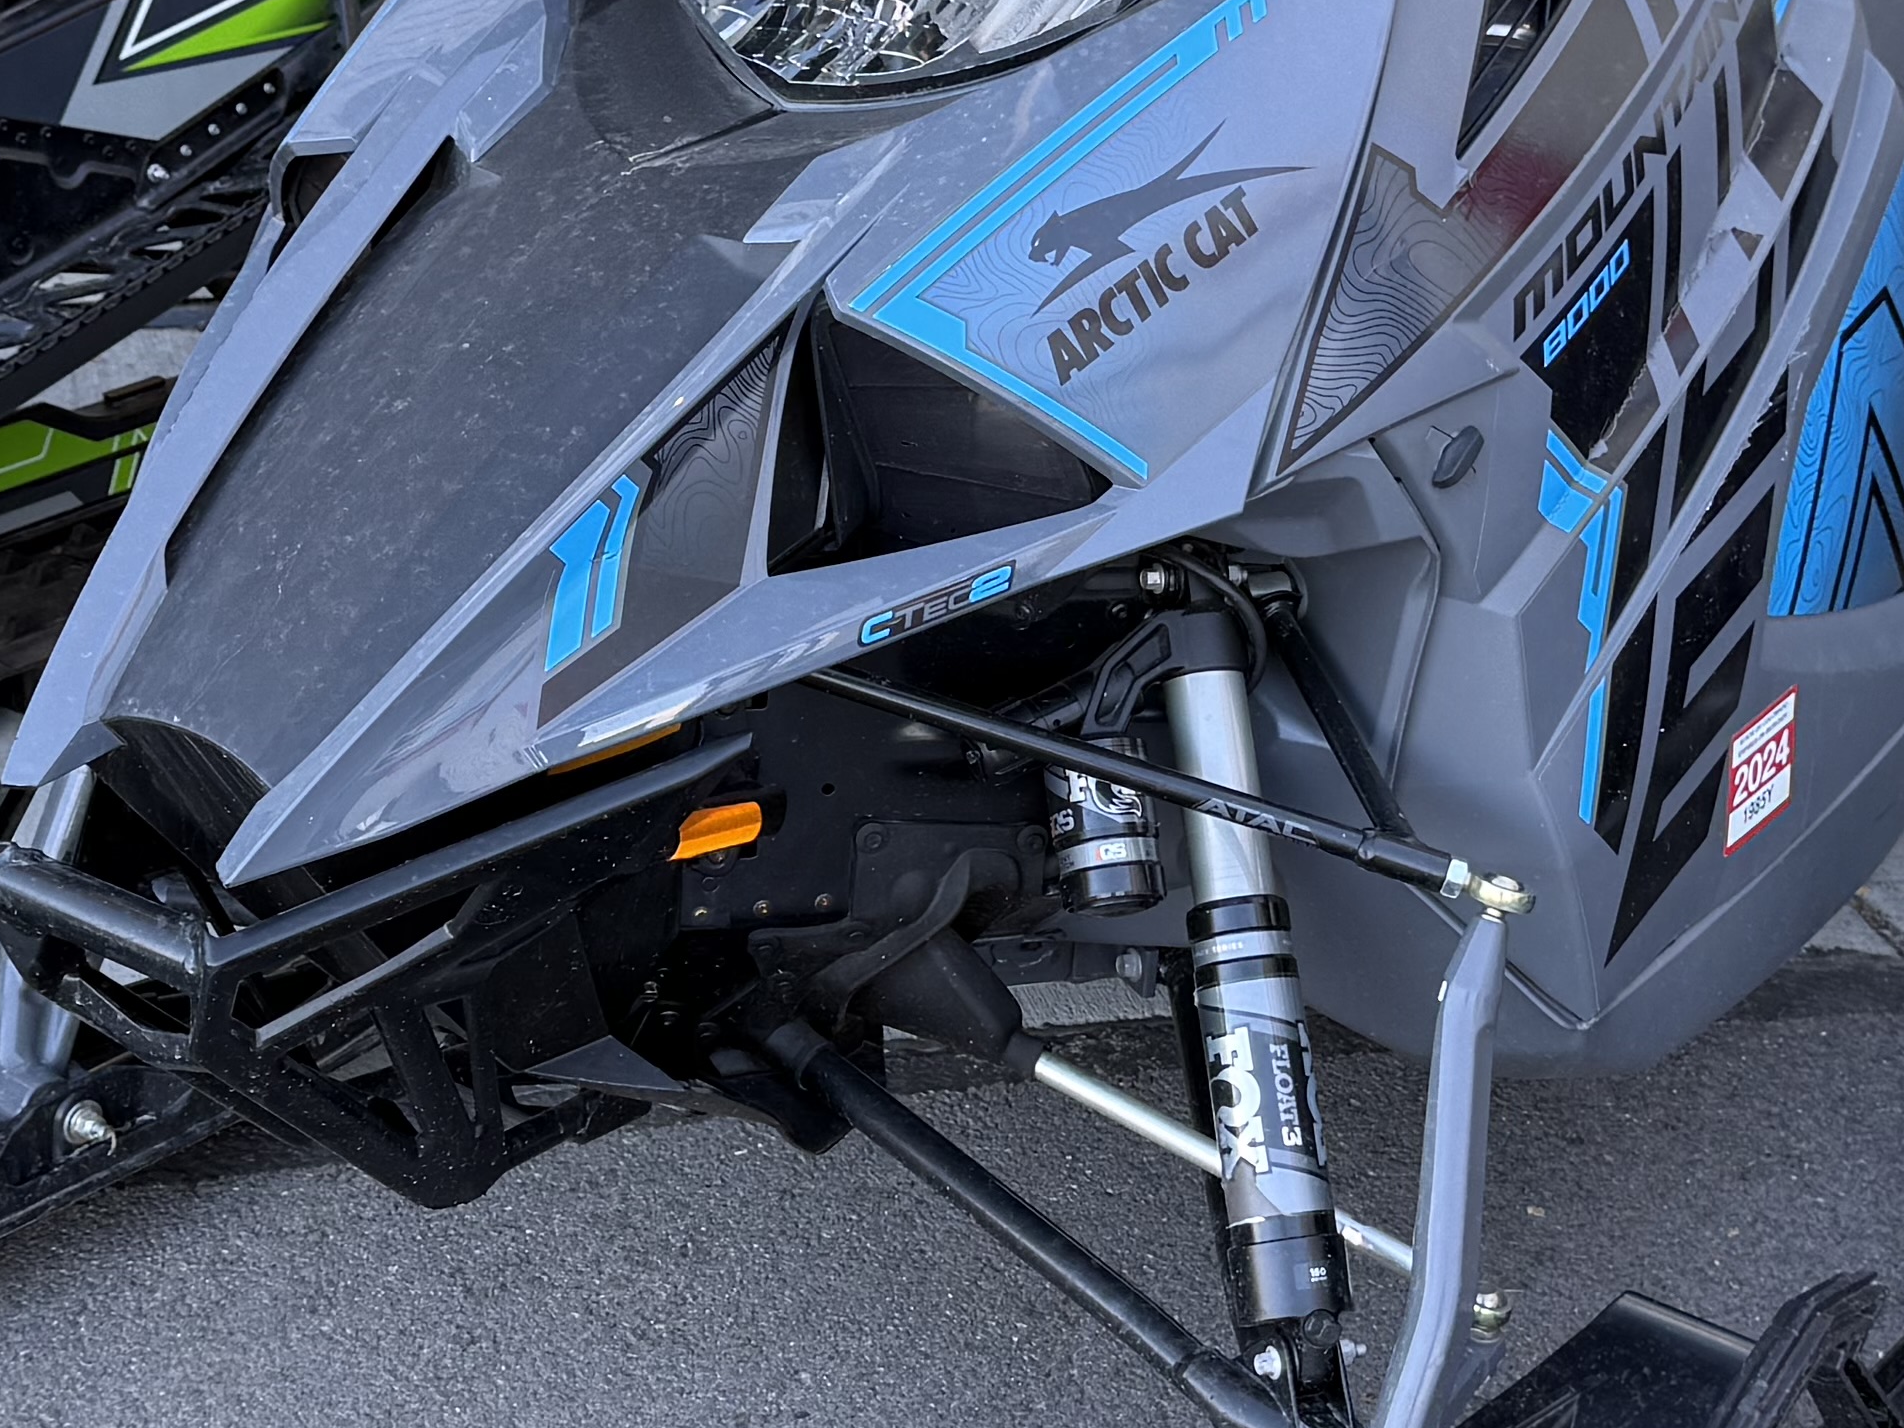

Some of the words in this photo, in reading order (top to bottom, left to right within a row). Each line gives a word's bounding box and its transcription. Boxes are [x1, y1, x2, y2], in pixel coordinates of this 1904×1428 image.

[1047, 242, 1191, 386] ARCTIC
[1183, 185, 1259, 269] CAT
[1543, 239, 1631, 368] 8000
[1733, 728, 1790, 807] 2024
[1206, 1026, 1269, 1180] FOX
[1269, 1043, 1299, 1125] FLOAT
[1281, 1126, 1302, 1147] 3
